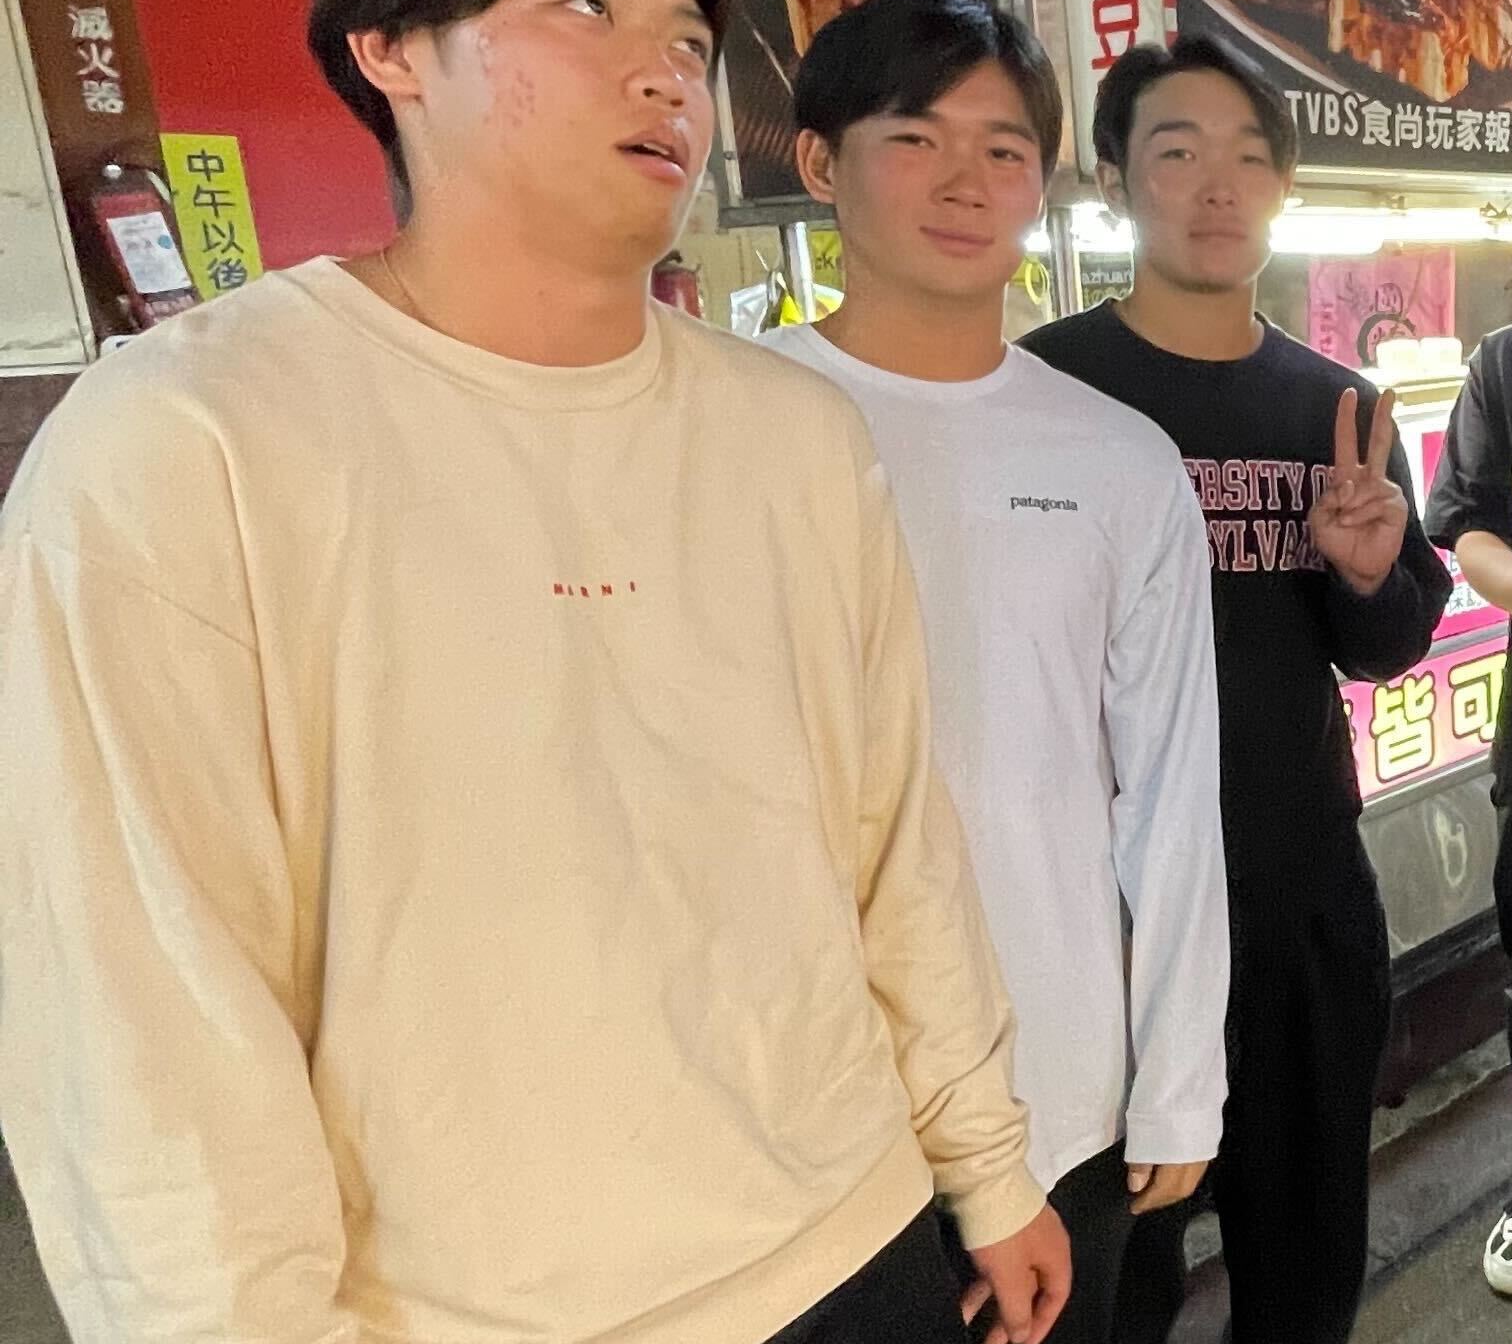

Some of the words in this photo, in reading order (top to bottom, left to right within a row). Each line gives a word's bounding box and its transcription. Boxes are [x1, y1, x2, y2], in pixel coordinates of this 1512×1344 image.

[187, 149, 248, 291] 中午以後
[1010, 496, 1078, 512] patagonia
